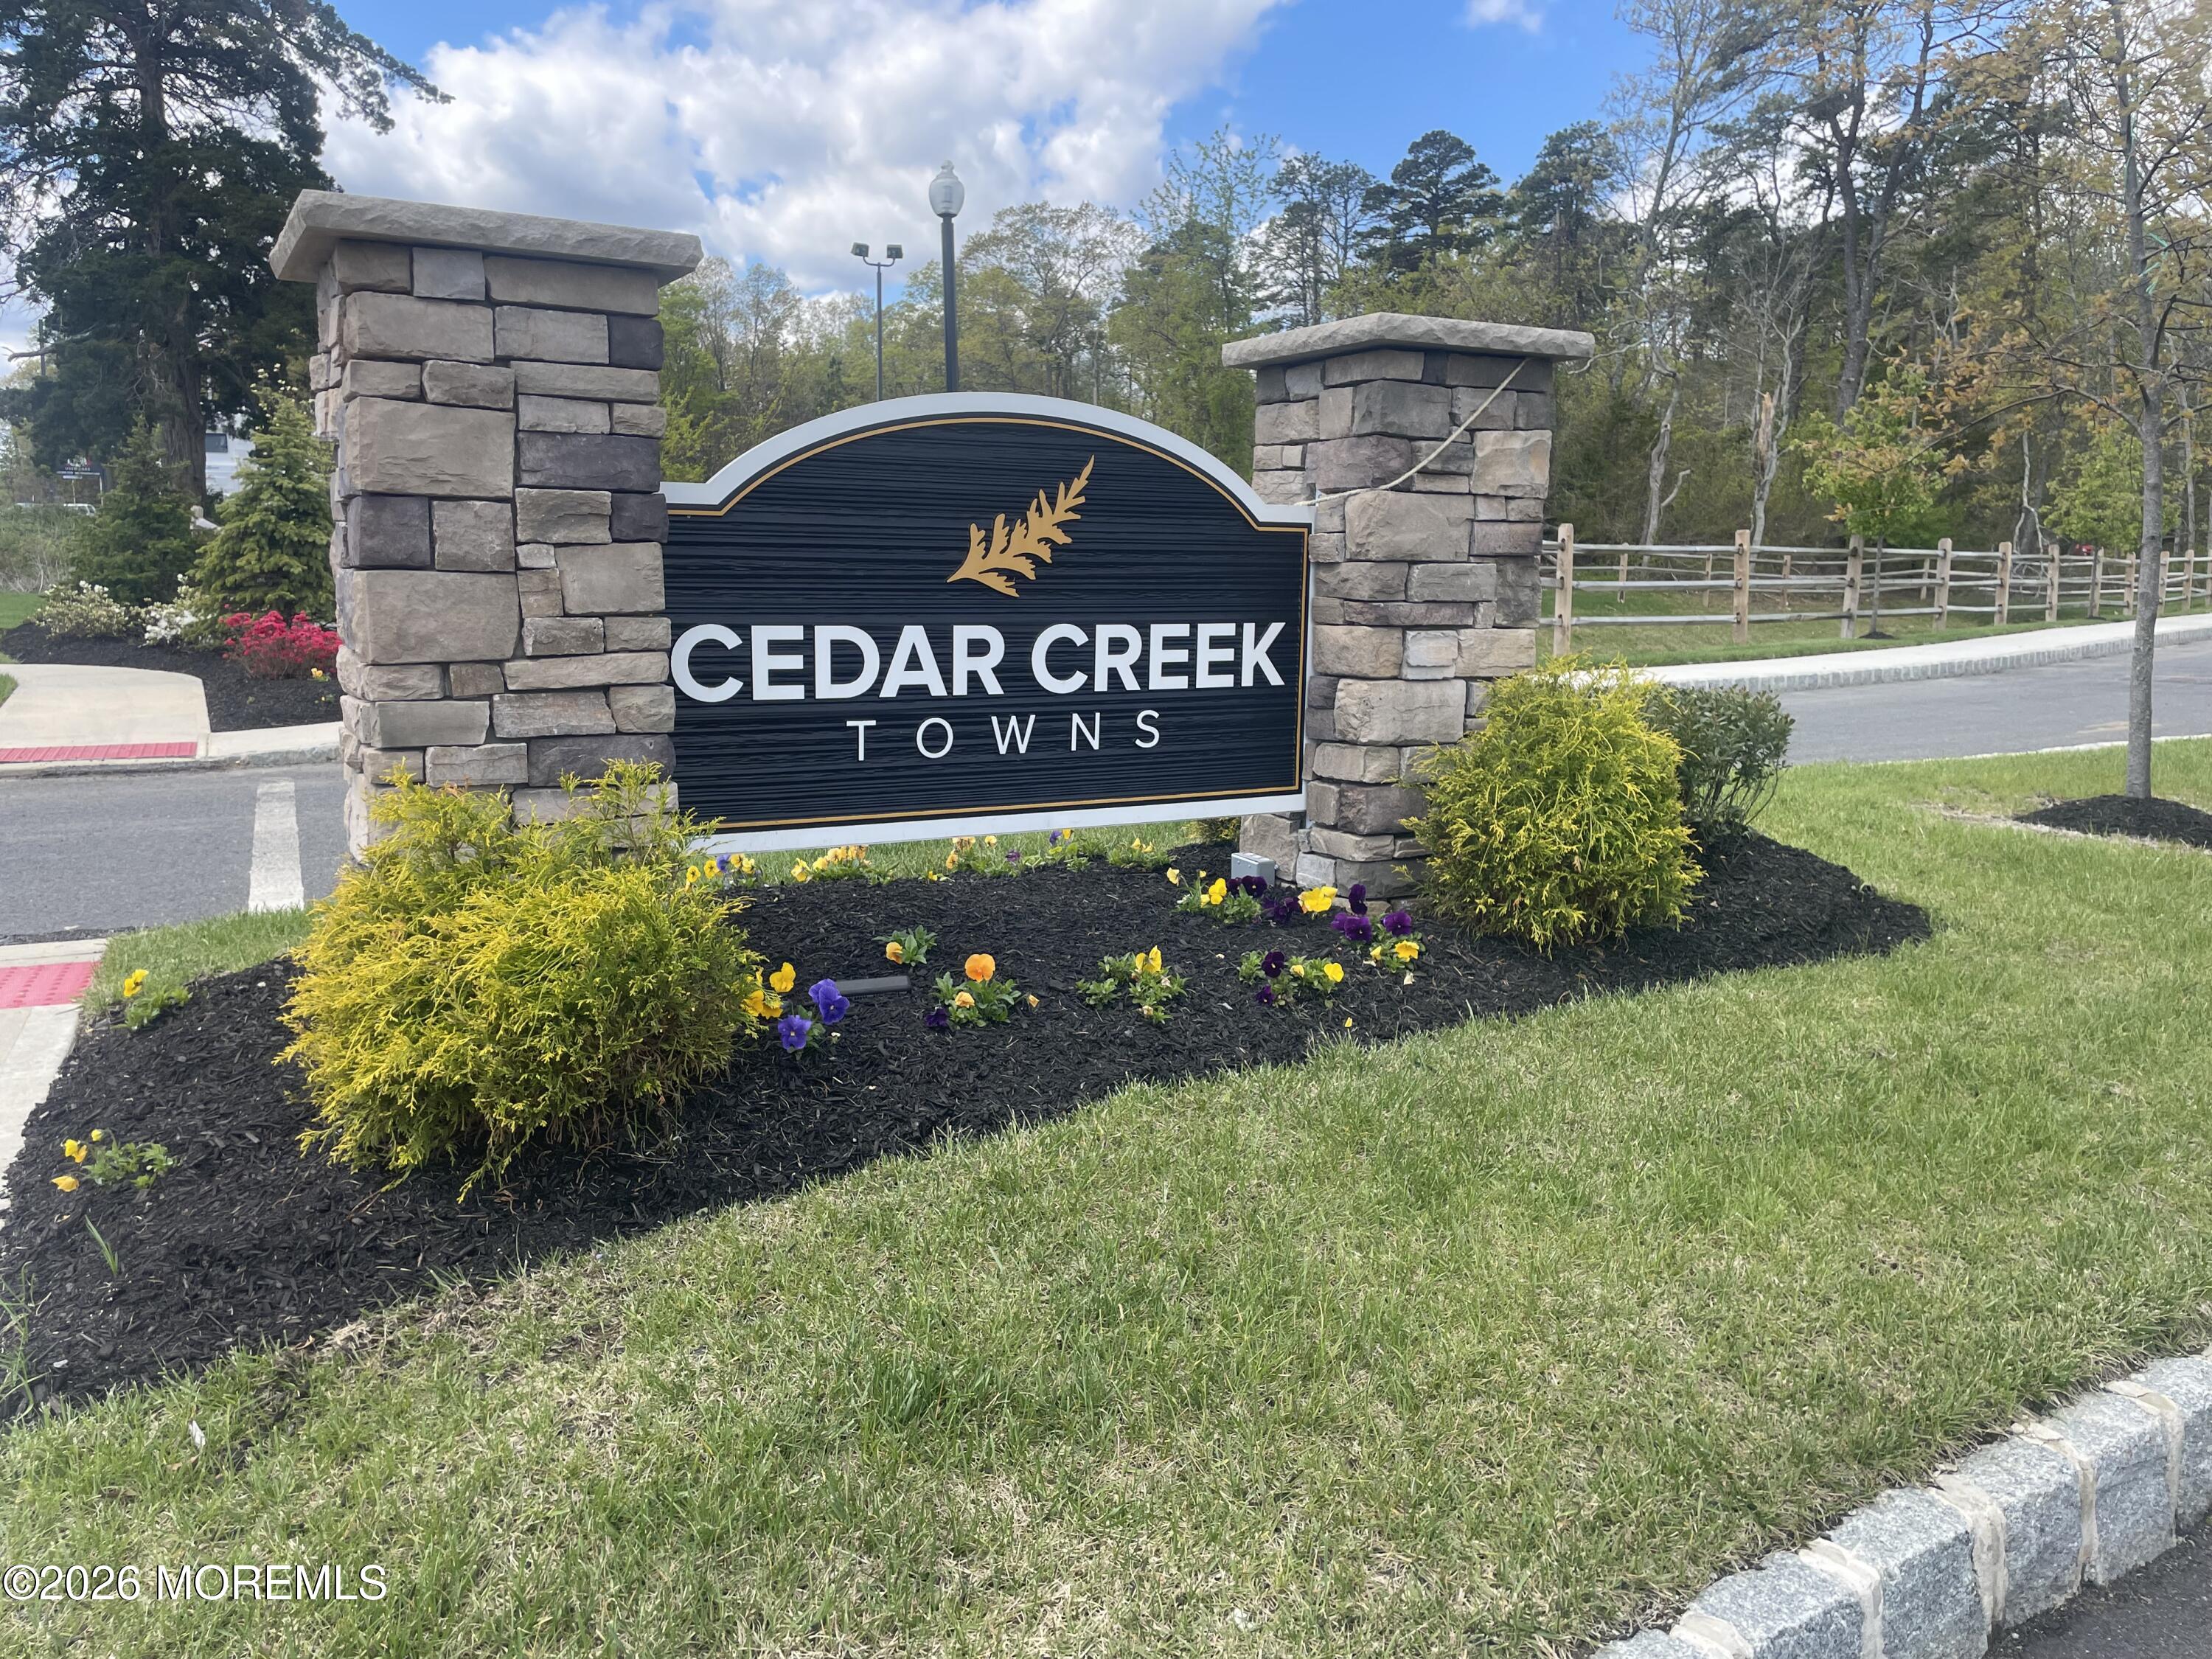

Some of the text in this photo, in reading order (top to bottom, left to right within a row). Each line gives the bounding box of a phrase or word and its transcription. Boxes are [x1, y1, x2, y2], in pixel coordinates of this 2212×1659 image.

[670, 622, 1286, 703] CEDAR CREEK
[846, 709, 1161, 762] TOWNS
